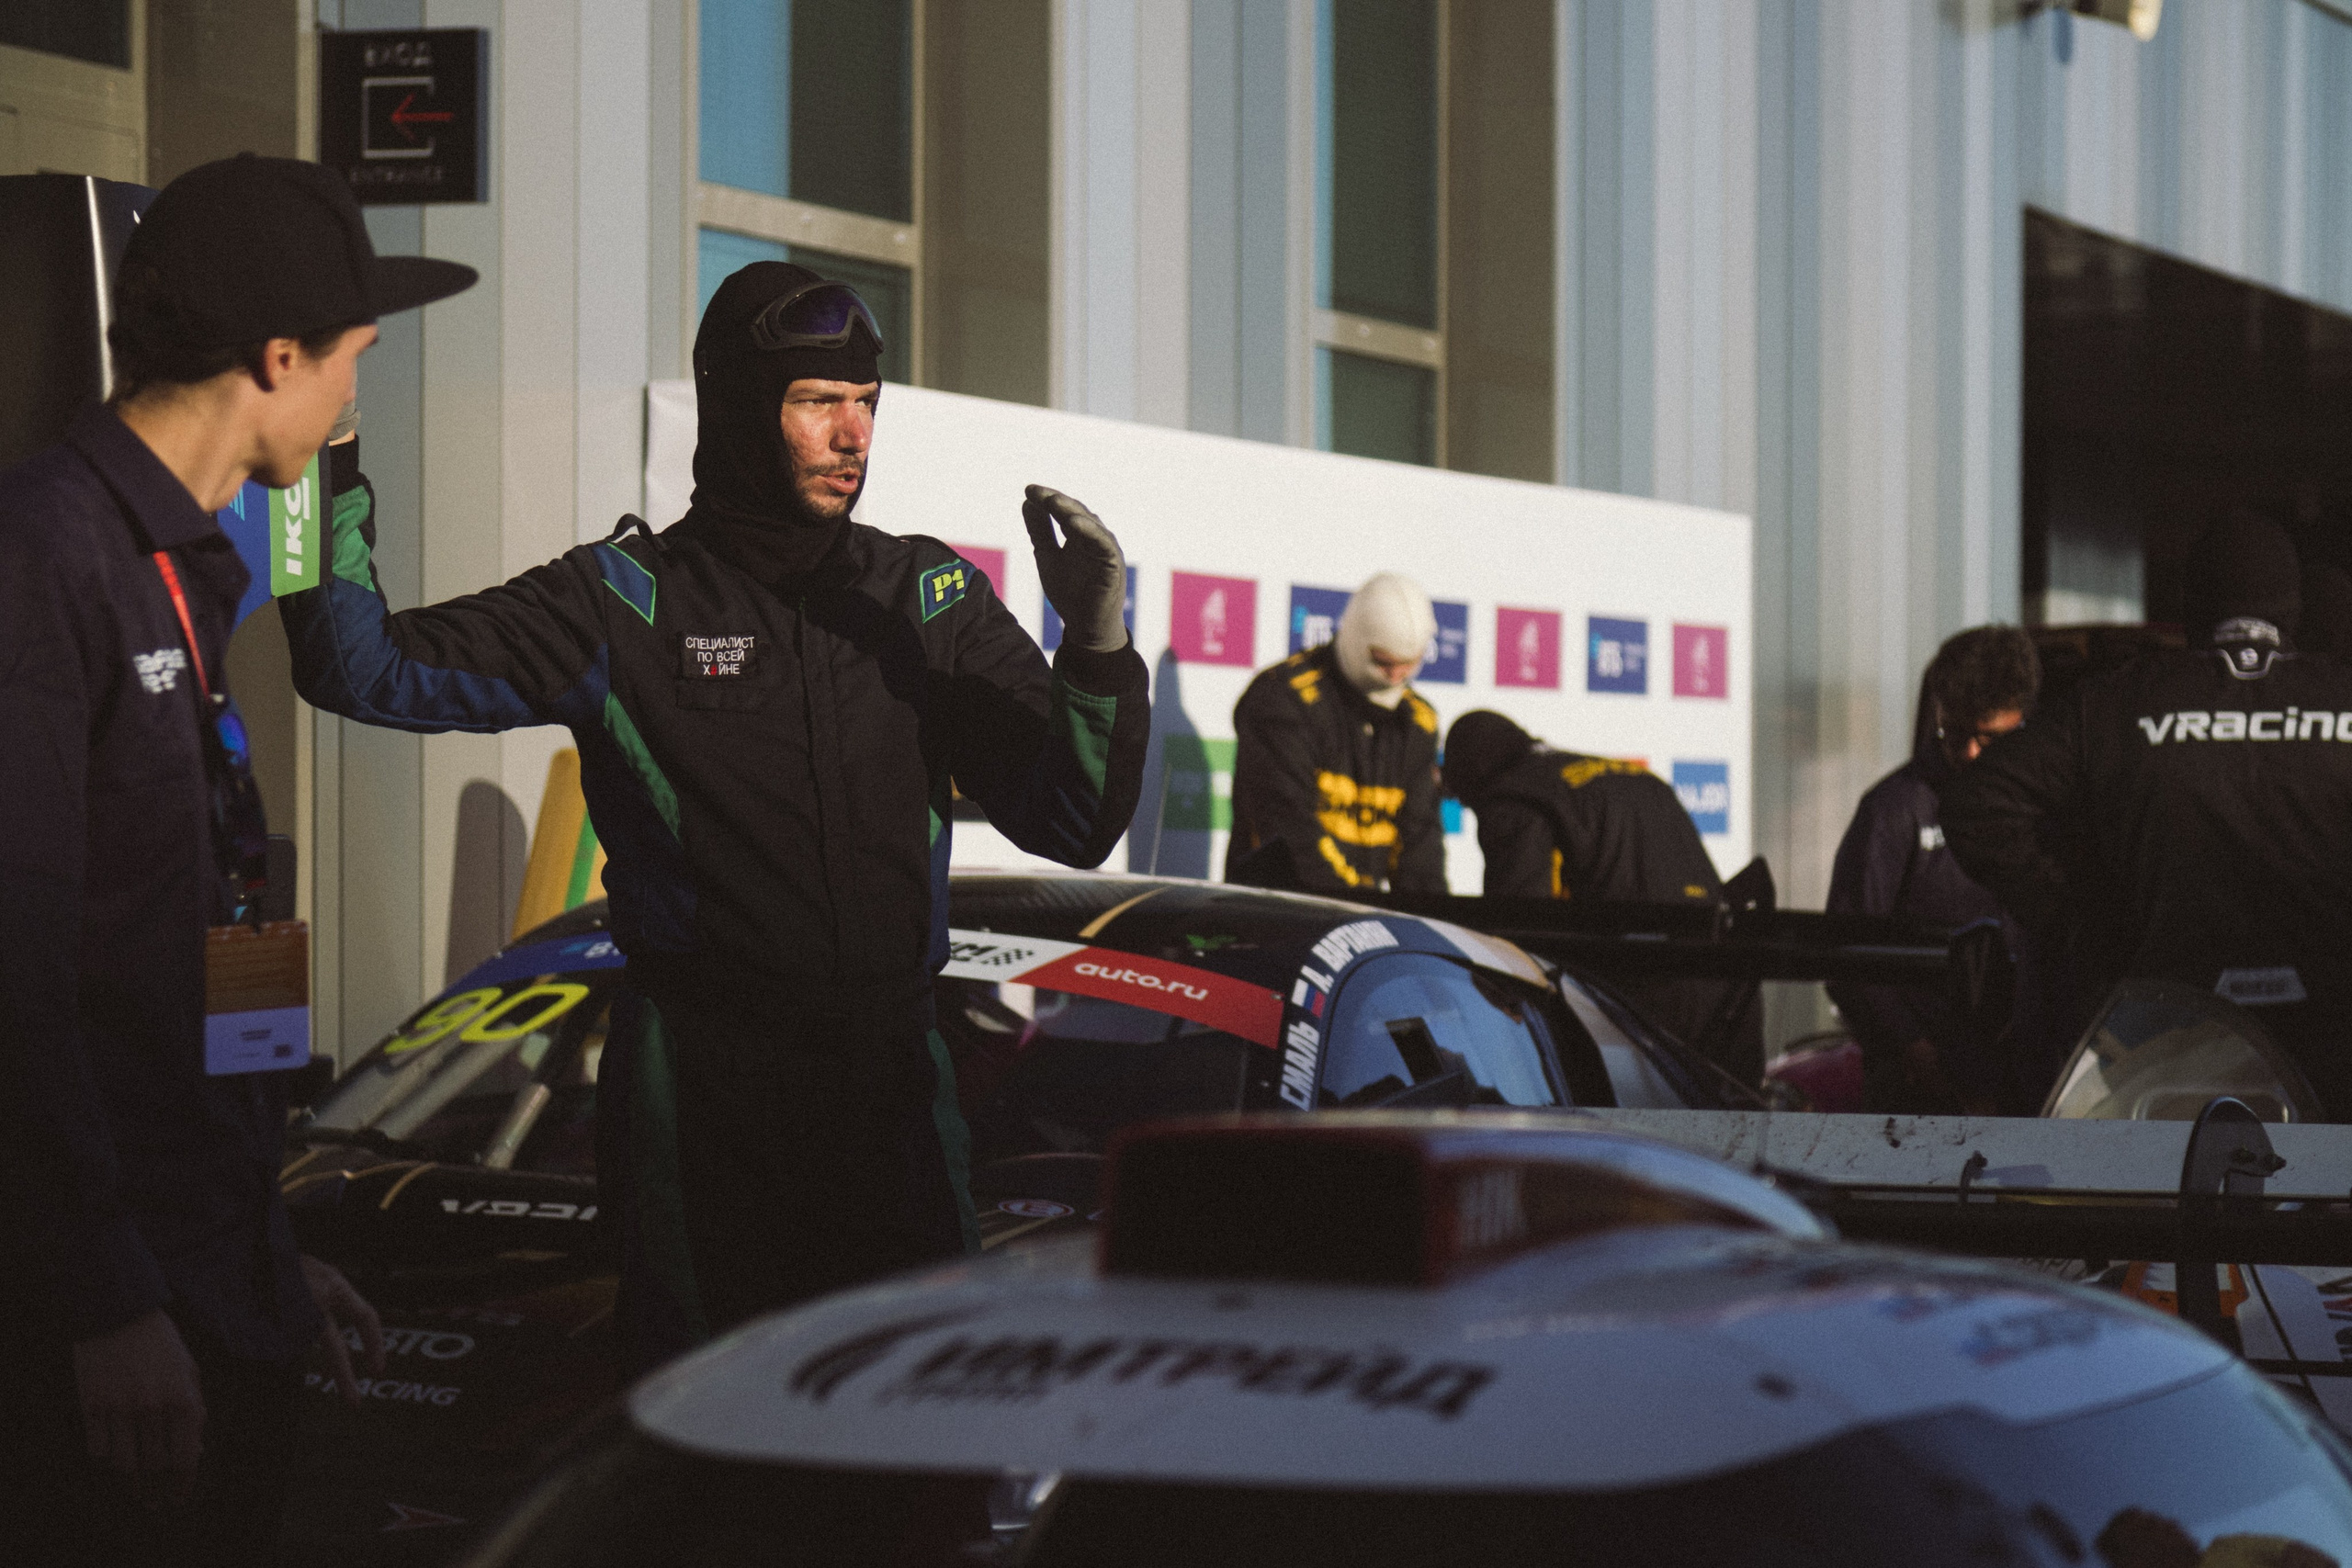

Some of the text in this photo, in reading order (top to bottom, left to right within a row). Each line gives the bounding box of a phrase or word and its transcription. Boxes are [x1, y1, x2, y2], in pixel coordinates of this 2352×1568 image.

[685, 636, 755, 651] СПЕЦИАЛИСТ
[696, 649, 745, 662] ПО ВСЕЙ
[1073, 962, 1209, 1001] auto.ru
[384, 982, 590, 1055] 90
[1280, 1021, 1320, 1112] СМАЛЬ
